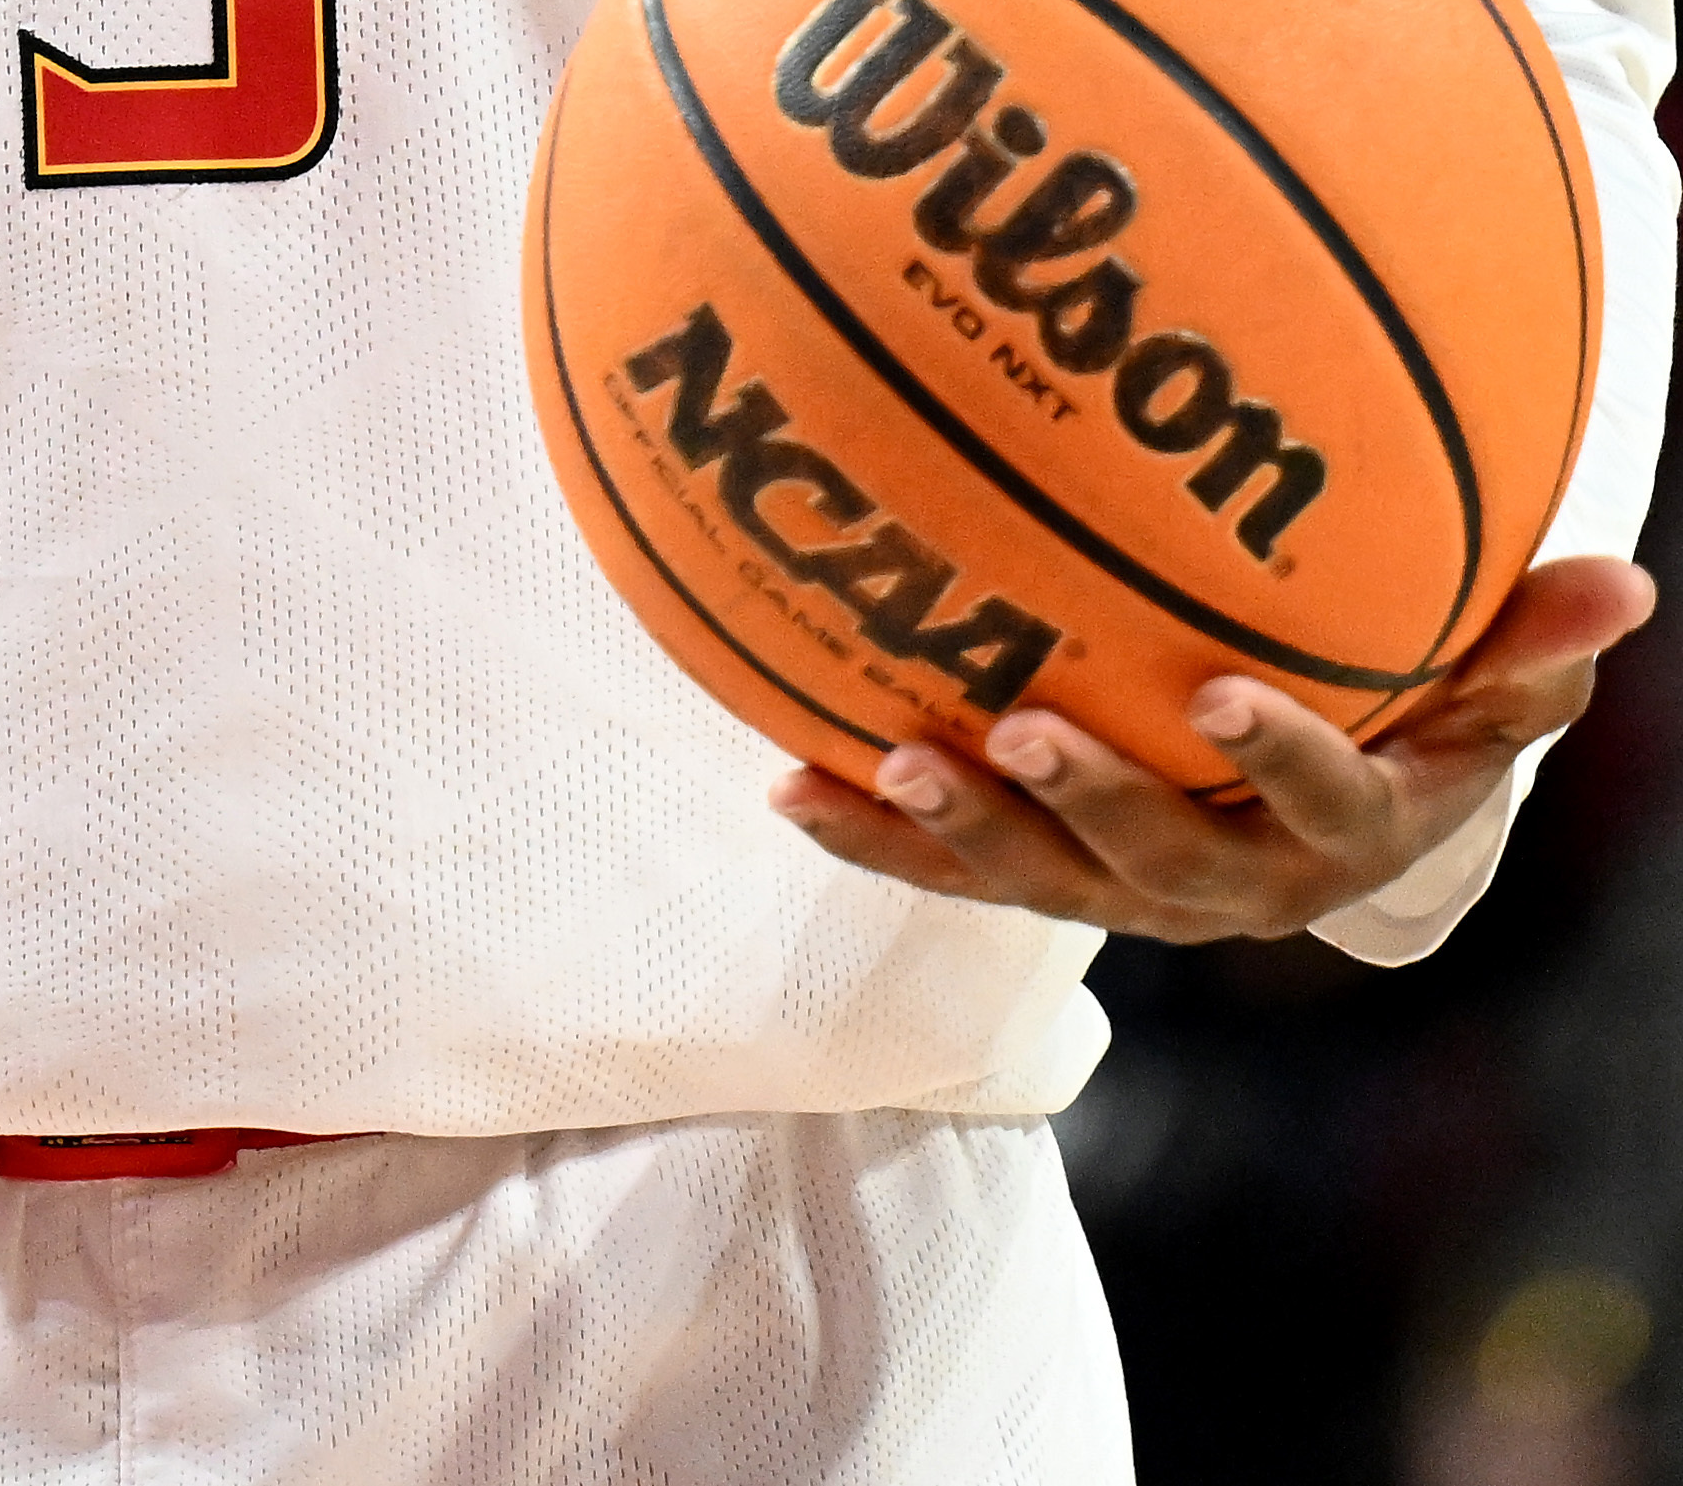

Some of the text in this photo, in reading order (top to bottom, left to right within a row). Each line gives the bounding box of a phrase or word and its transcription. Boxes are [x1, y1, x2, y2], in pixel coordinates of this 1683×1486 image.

[903, 259, 1080, 421] EVO NXT
[624, 302, 1063, 714] NCAA
